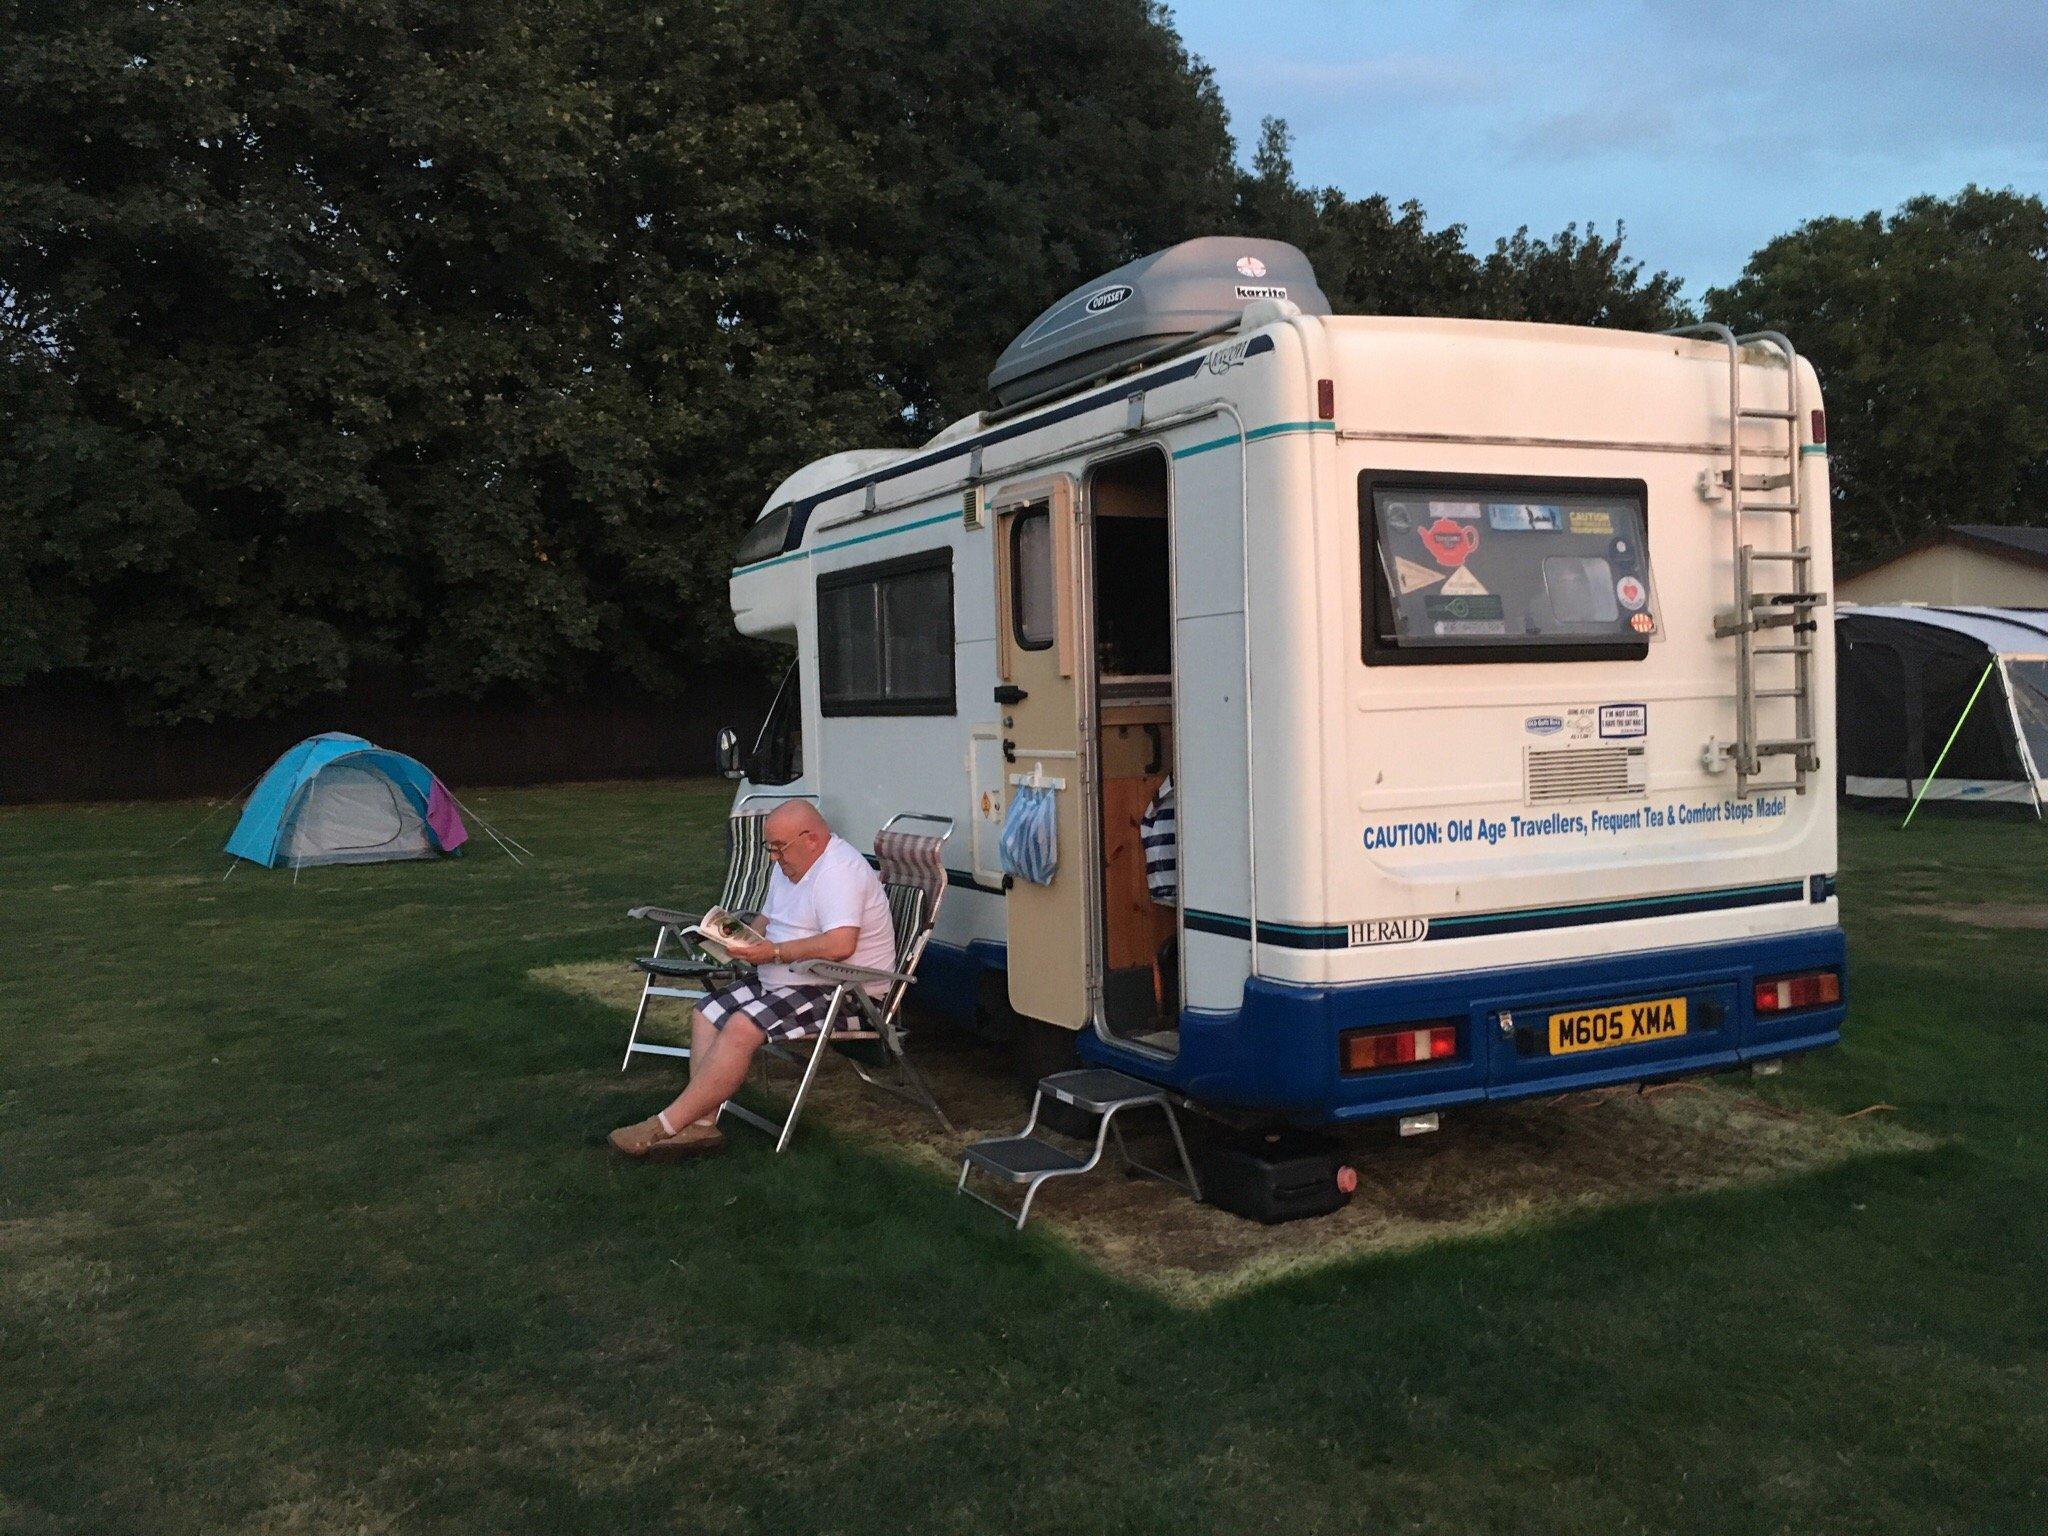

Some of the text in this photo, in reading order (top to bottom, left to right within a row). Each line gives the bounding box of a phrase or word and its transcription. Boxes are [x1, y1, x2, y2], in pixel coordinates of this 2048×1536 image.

[1092, 288, 1126, 309] ODYSSEY
[1363, 796, 1786, 849] CAUTION: Old Age Travellers, Frequent Tea & Comfort Stops Made!
[1351, 920, 1425, 945] HERALD
[1559, 1004, 1676, 1048] M605 XMA
